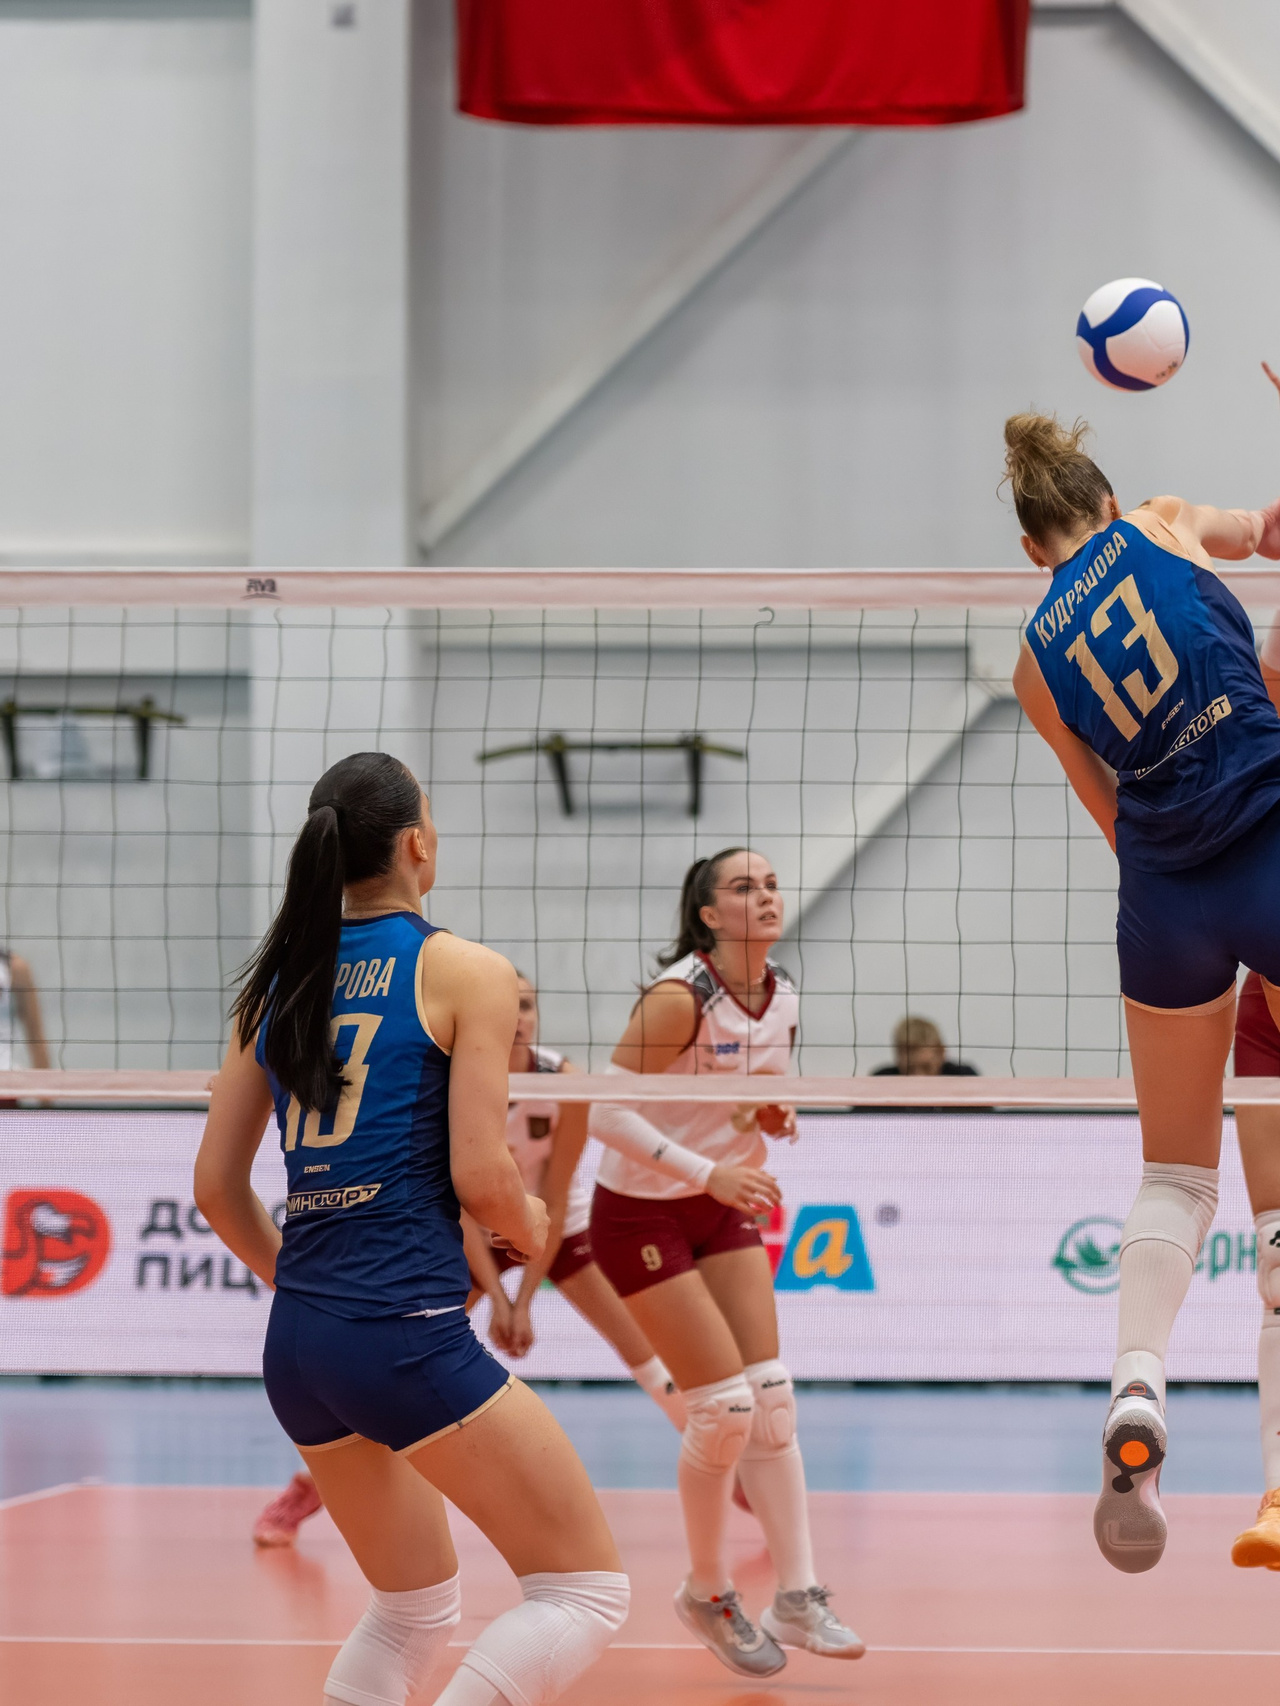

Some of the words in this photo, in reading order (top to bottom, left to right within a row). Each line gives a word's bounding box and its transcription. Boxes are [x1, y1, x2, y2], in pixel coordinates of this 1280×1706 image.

[1064, 574, 1180, 742] 13
[336, 957, 396, 999] РОВА
[641, 1244, 663, 1272] 9
